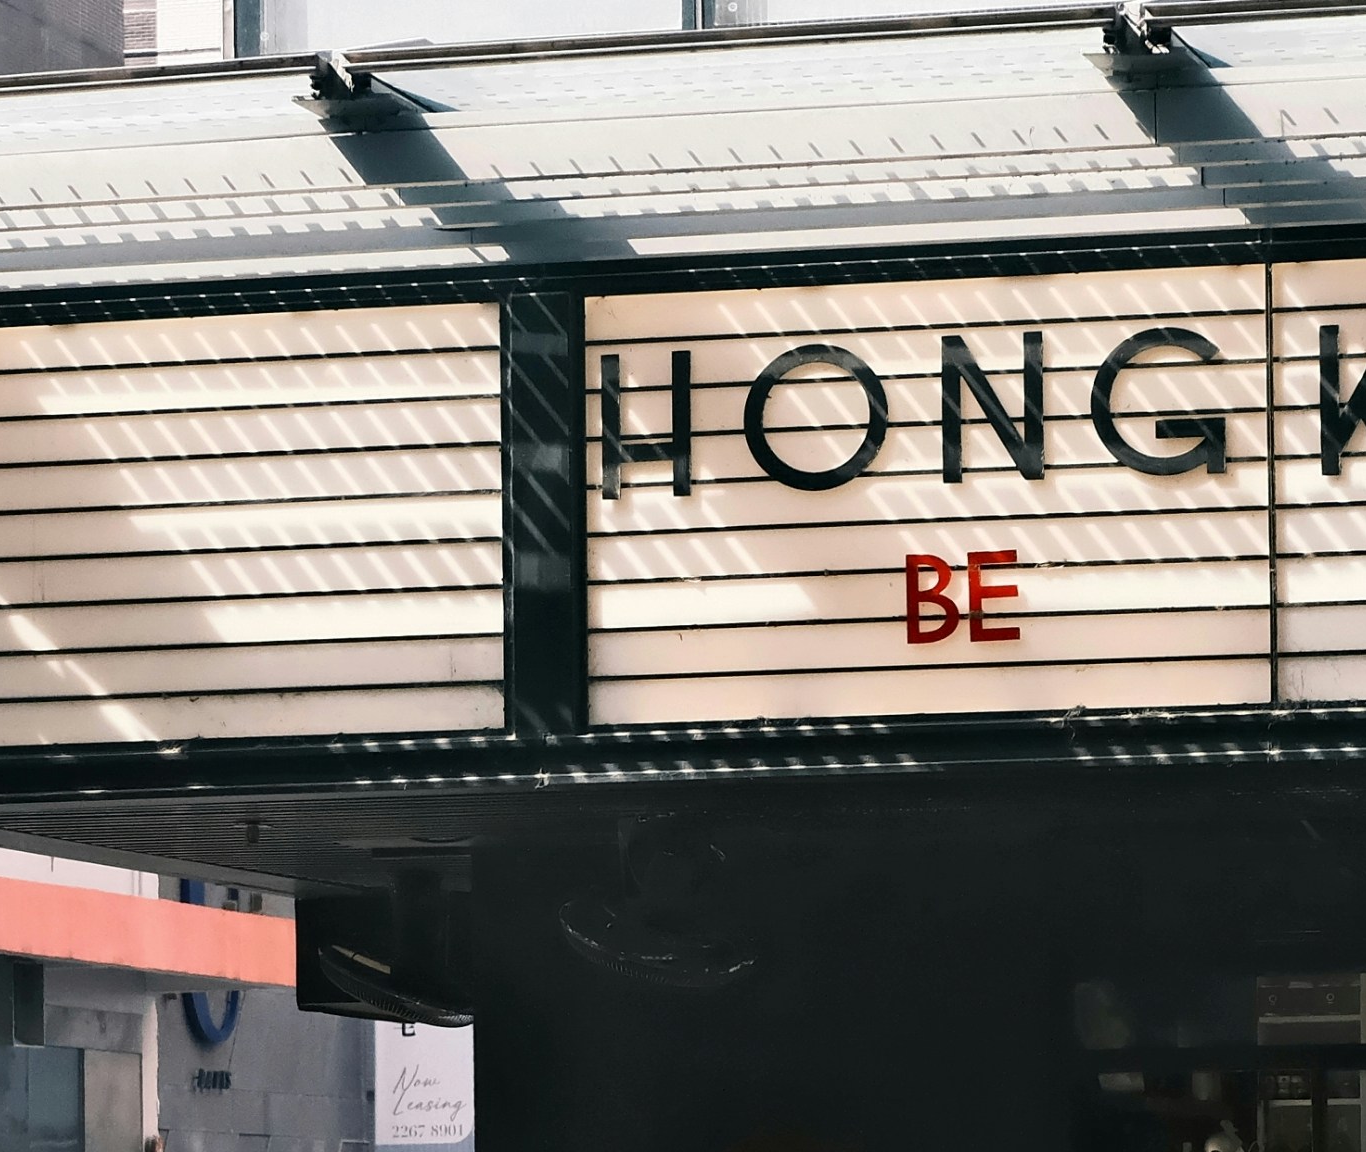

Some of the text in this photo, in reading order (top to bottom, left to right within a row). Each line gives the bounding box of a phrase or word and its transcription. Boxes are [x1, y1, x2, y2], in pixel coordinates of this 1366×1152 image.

[599, 325, 1227, 501] HONG
[906, 549, 1022, 645] BE
[392, 1063, 440, 1094] Now
[392, 1090, 467, 1122] Leasing
[391, 1123, 464, 1138] 2267 8901
